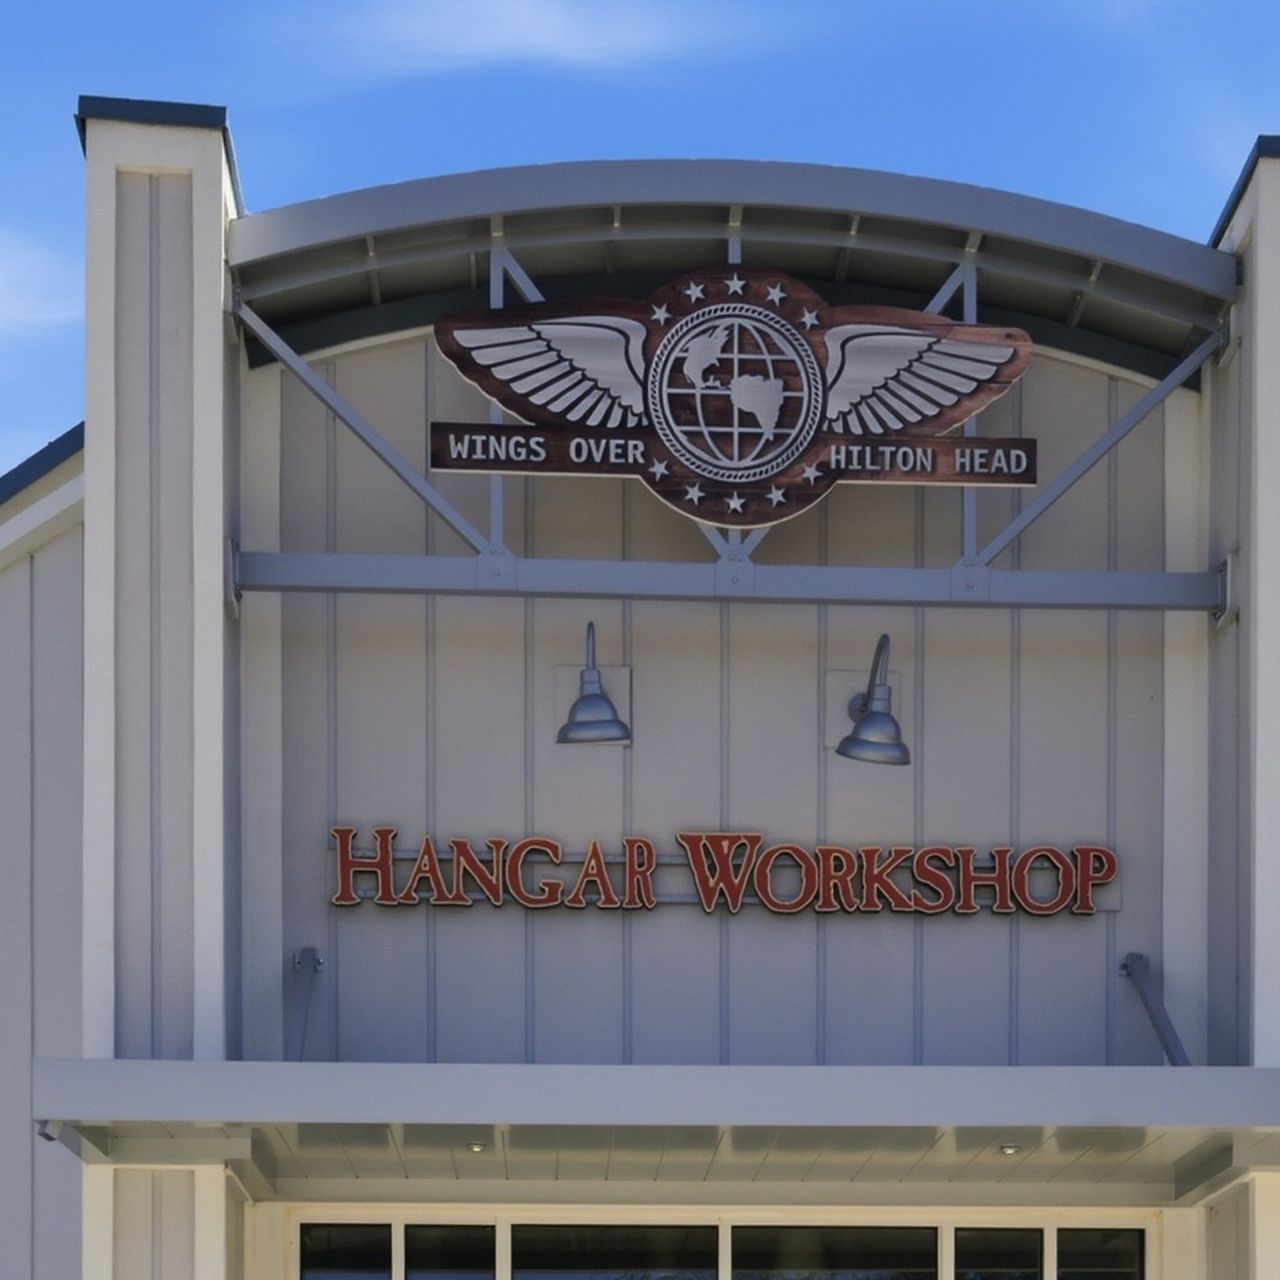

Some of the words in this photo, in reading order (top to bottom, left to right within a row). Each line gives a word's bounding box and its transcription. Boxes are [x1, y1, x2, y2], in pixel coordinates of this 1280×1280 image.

[448, 433, 547, 463] WINGS
[569, 439, 646, 464] OVER
[829, 445, 933, 472] HILTON
[954, 449, 1028, 474] HEAD
[331, 826, 657, 910] HANGAR
[677, 831, 1118, 915] WORKSHOP
